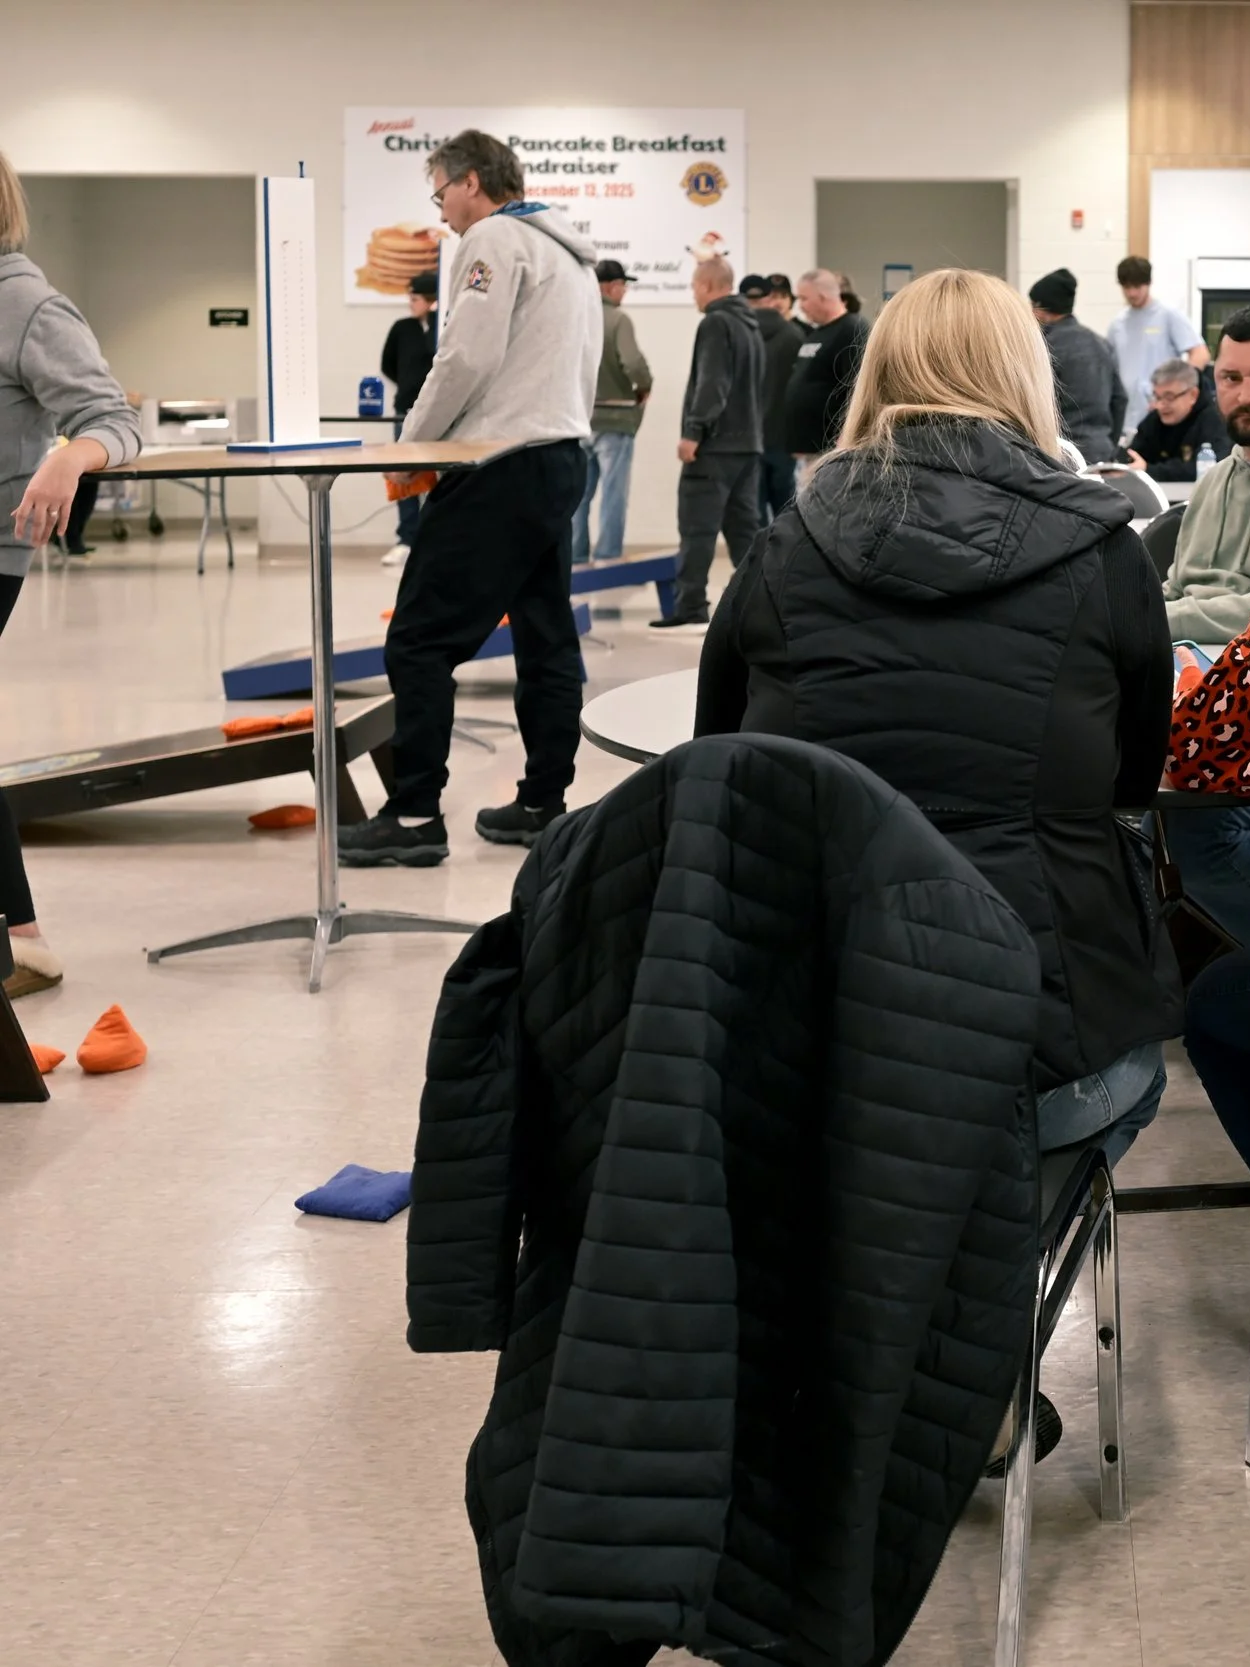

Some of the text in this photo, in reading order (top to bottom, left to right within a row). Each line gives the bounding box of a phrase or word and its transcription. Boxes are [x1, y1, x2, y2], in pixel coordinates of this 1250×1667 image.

[508, 135, 606, 152] Pancake
[612, 135, 726, 152] Breakfast
[523, 157, 619, 174] ndraiser
[524, 184, 580, 197] ecember
[604, 182, 635, 197] 2025
